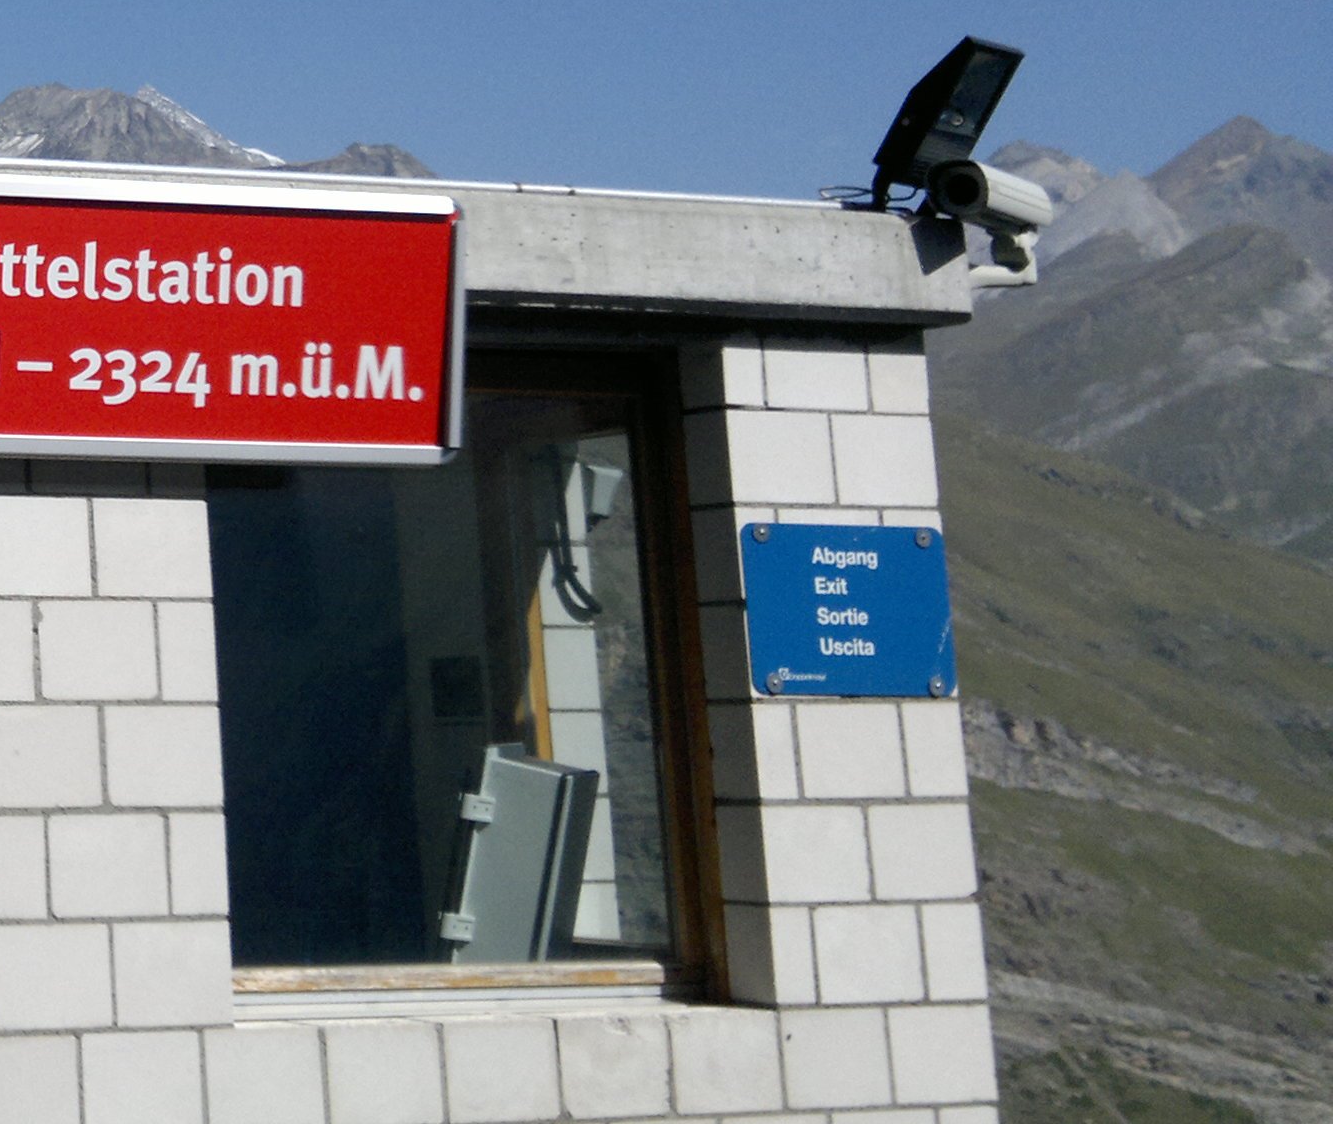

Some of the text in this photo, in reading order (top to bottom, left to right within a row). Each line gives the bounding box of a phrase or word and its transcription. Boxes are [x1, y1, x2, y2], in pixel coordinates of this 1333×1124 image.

[69, 347, 211, 408] 2324
[230, 341, 423, 402] m.ü.M.
[812, 546, 878, 570] Abgang
[814, 576, 848, 595] Exit
[816, 606, 869, 626] Sortie
[819, 637, 876, 656] Uscita
